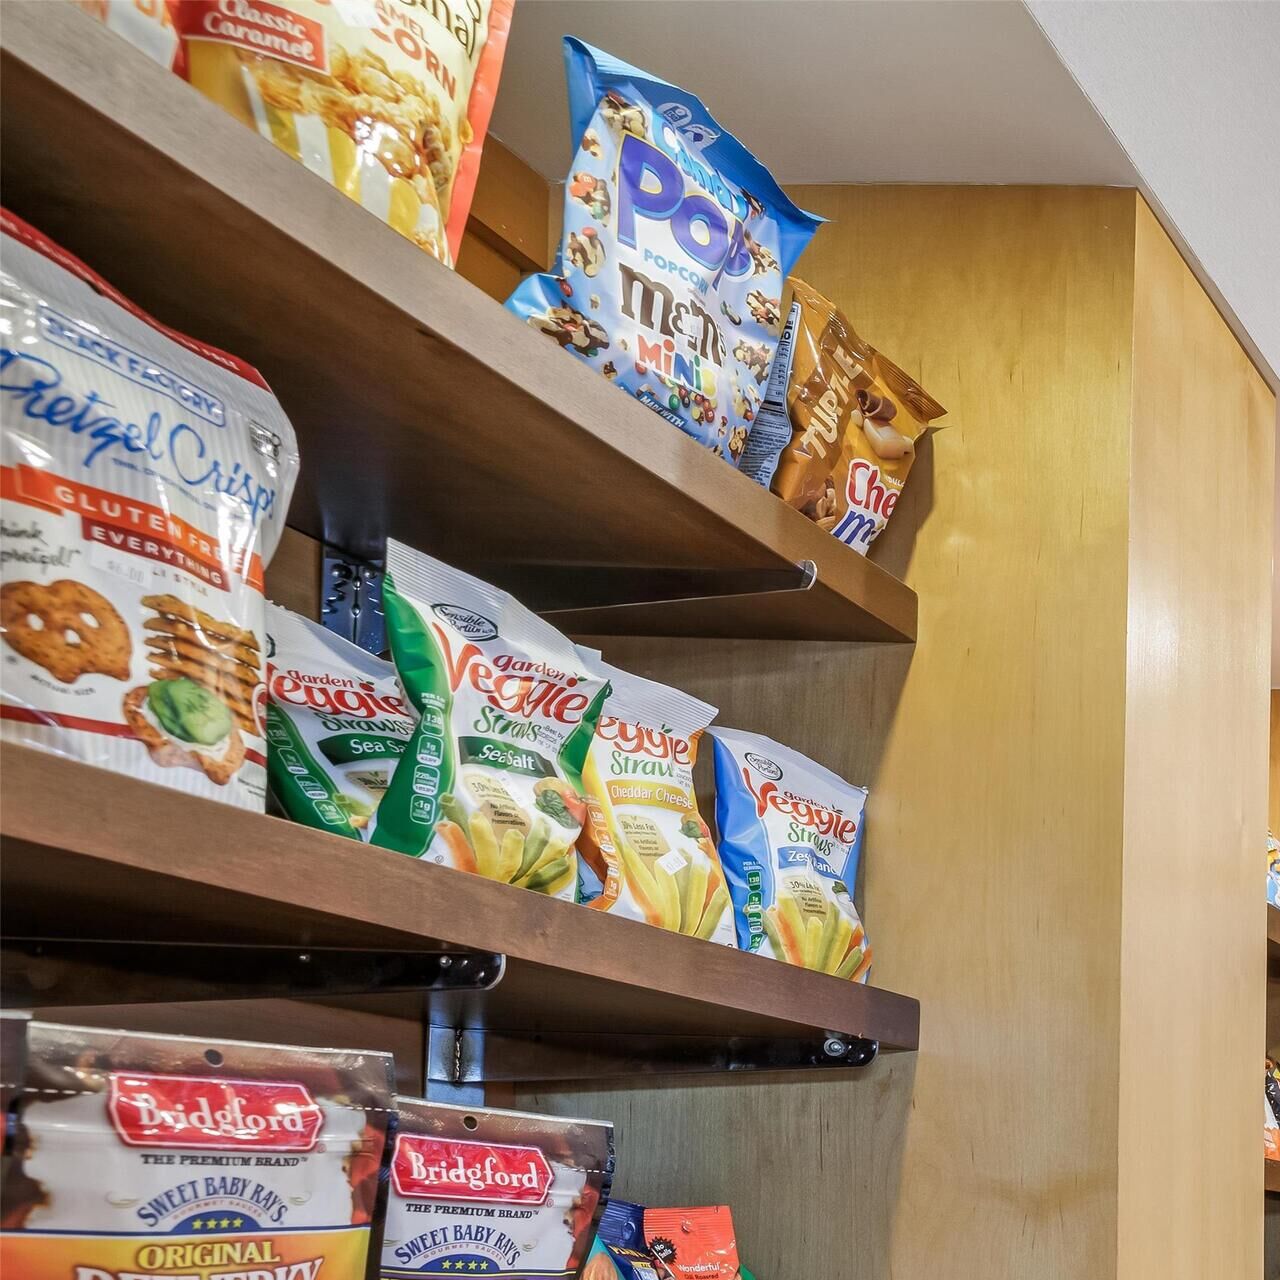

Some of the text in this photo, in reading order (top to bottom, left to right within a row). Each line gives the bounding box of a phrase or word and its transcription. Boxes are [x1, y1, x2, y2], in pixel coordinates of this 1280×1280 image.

[204, 12, 316, 61] Caramel
[661, 409, 685, 427] WITH
[55, 487, 182, 540] GLUTEN
[92, 526, 223, 585] EVERYTHING
[439, 605, 486, 628] Sensible
[287, 670, 354, 689] garden
[432, 621, 590, 725] Veggie
[493, 654, 566, 681] garden
[350, 739, 385, 754] Sea
[479, 745, 536, 771] Sea Salt
[611, 785, 652, 799] Cheddar
[783, 790, 830, 810] garden
[743, 767, 857, 845] Veggie
[788, 822, 835, 857] Straws
[136, 1096, 305, 1138] Bridgford
[141, 1153, 300, 1167] THE PREMIUM BRAND
[409, 1151, 539, 1190] Bridgford
[137, 1176, 288, 1227] SWEET BABY RAY'S
[406, 1204, 533, 1219] THE PREMIUM BRAND
[137, 1241, 280, 1270] ORIGINAL
[395, 1225, 520, 1267] SWEET BABY RAY'S
[423, 1244, 469, 1259] GOURMET
[654, 1243, 665, 1252] No
